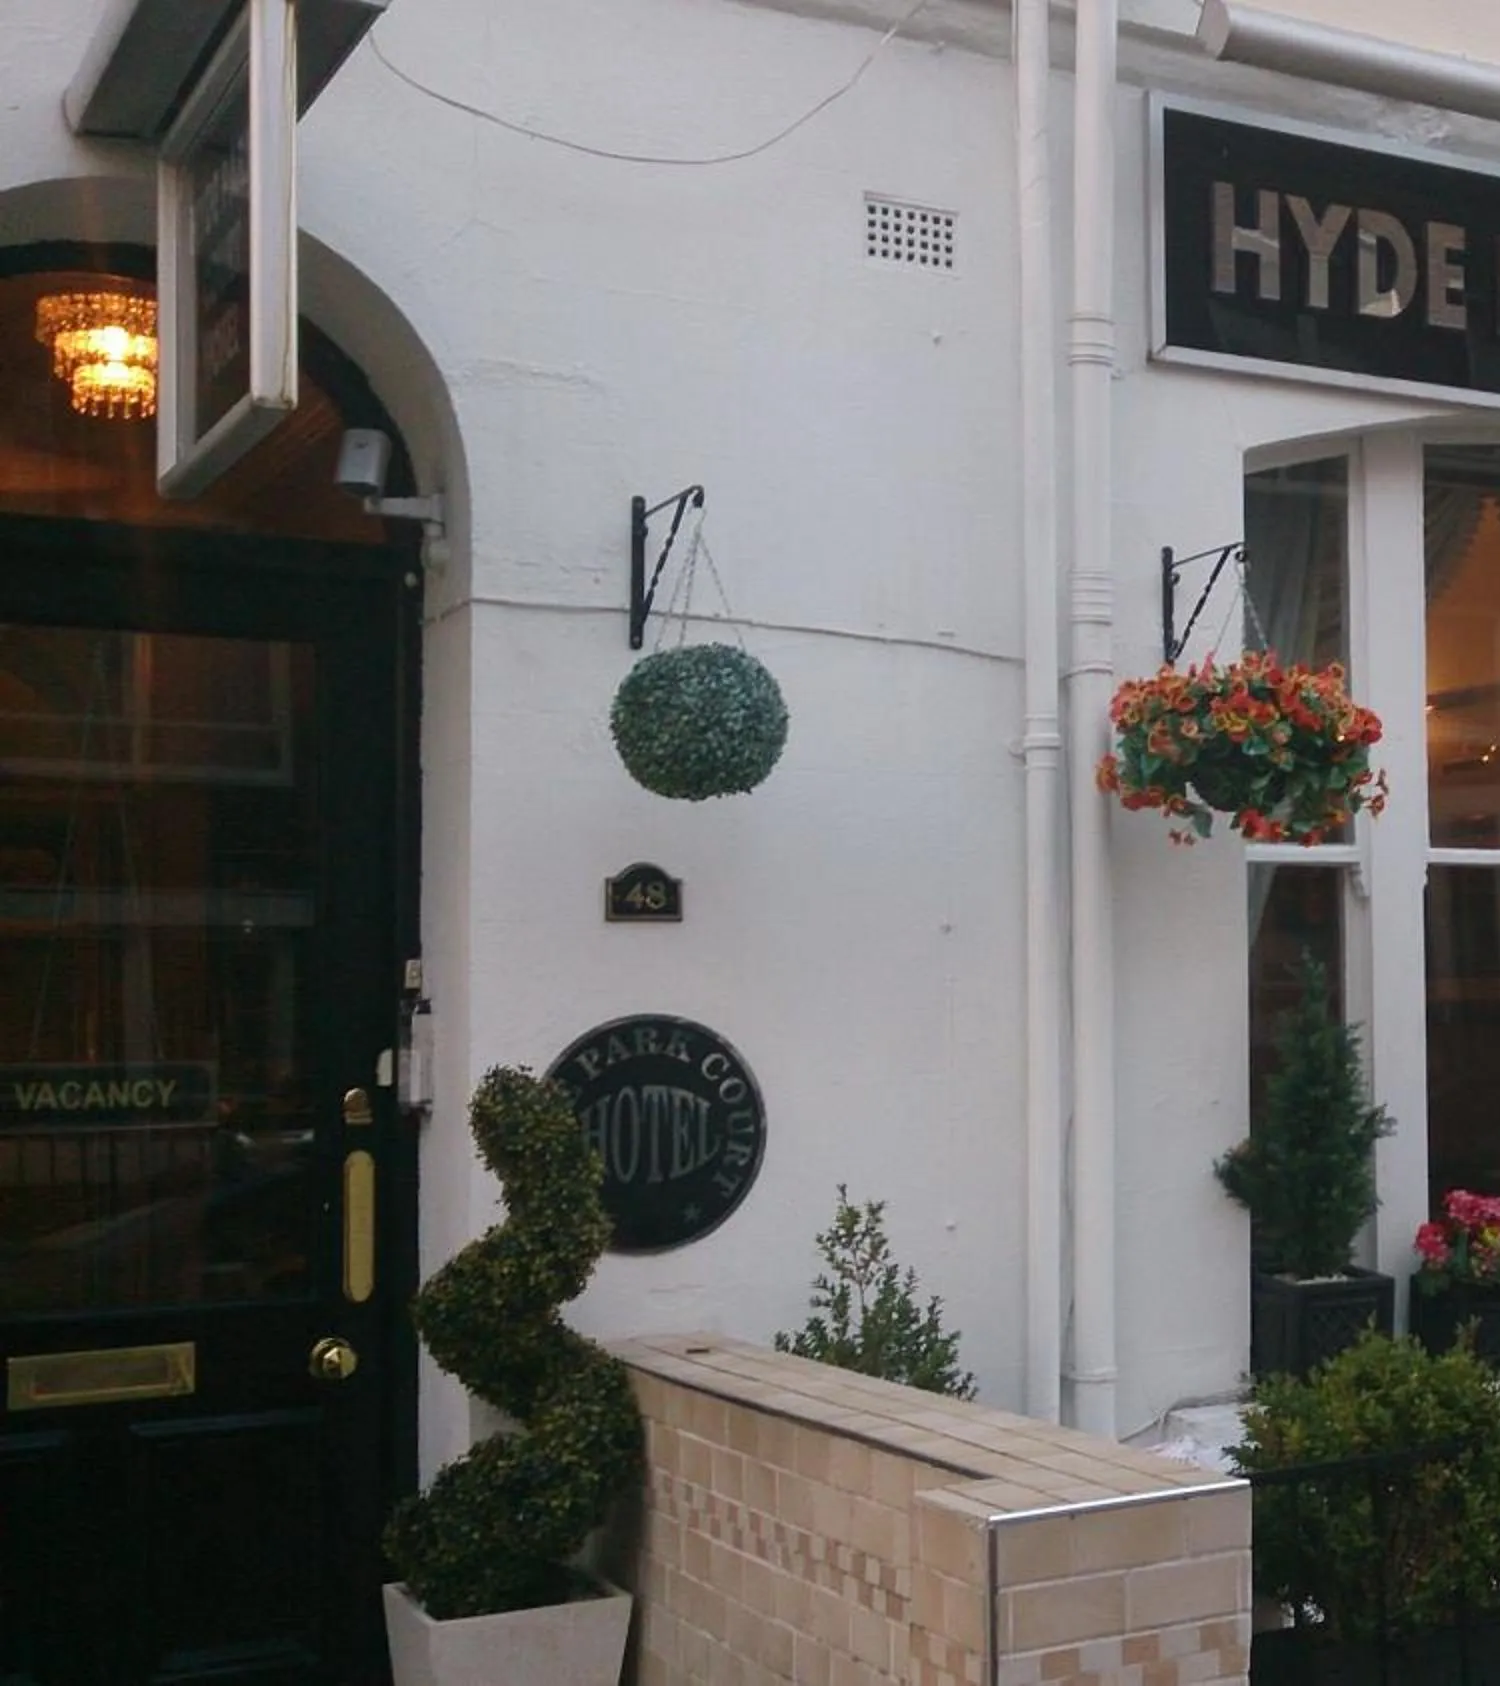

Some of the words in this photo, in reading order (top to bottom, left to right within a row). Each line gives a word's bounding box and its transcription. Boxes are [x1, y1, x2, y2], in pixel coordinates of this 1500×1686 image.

[1211, 181, 1468, 331] HYDE
[624, 880, 667, 910] 48
[13, 1079, 177, 1111] VACANCY
[575, 1026, 693, 1080] PARK
[701, 1052, 755, 1199] COURT
